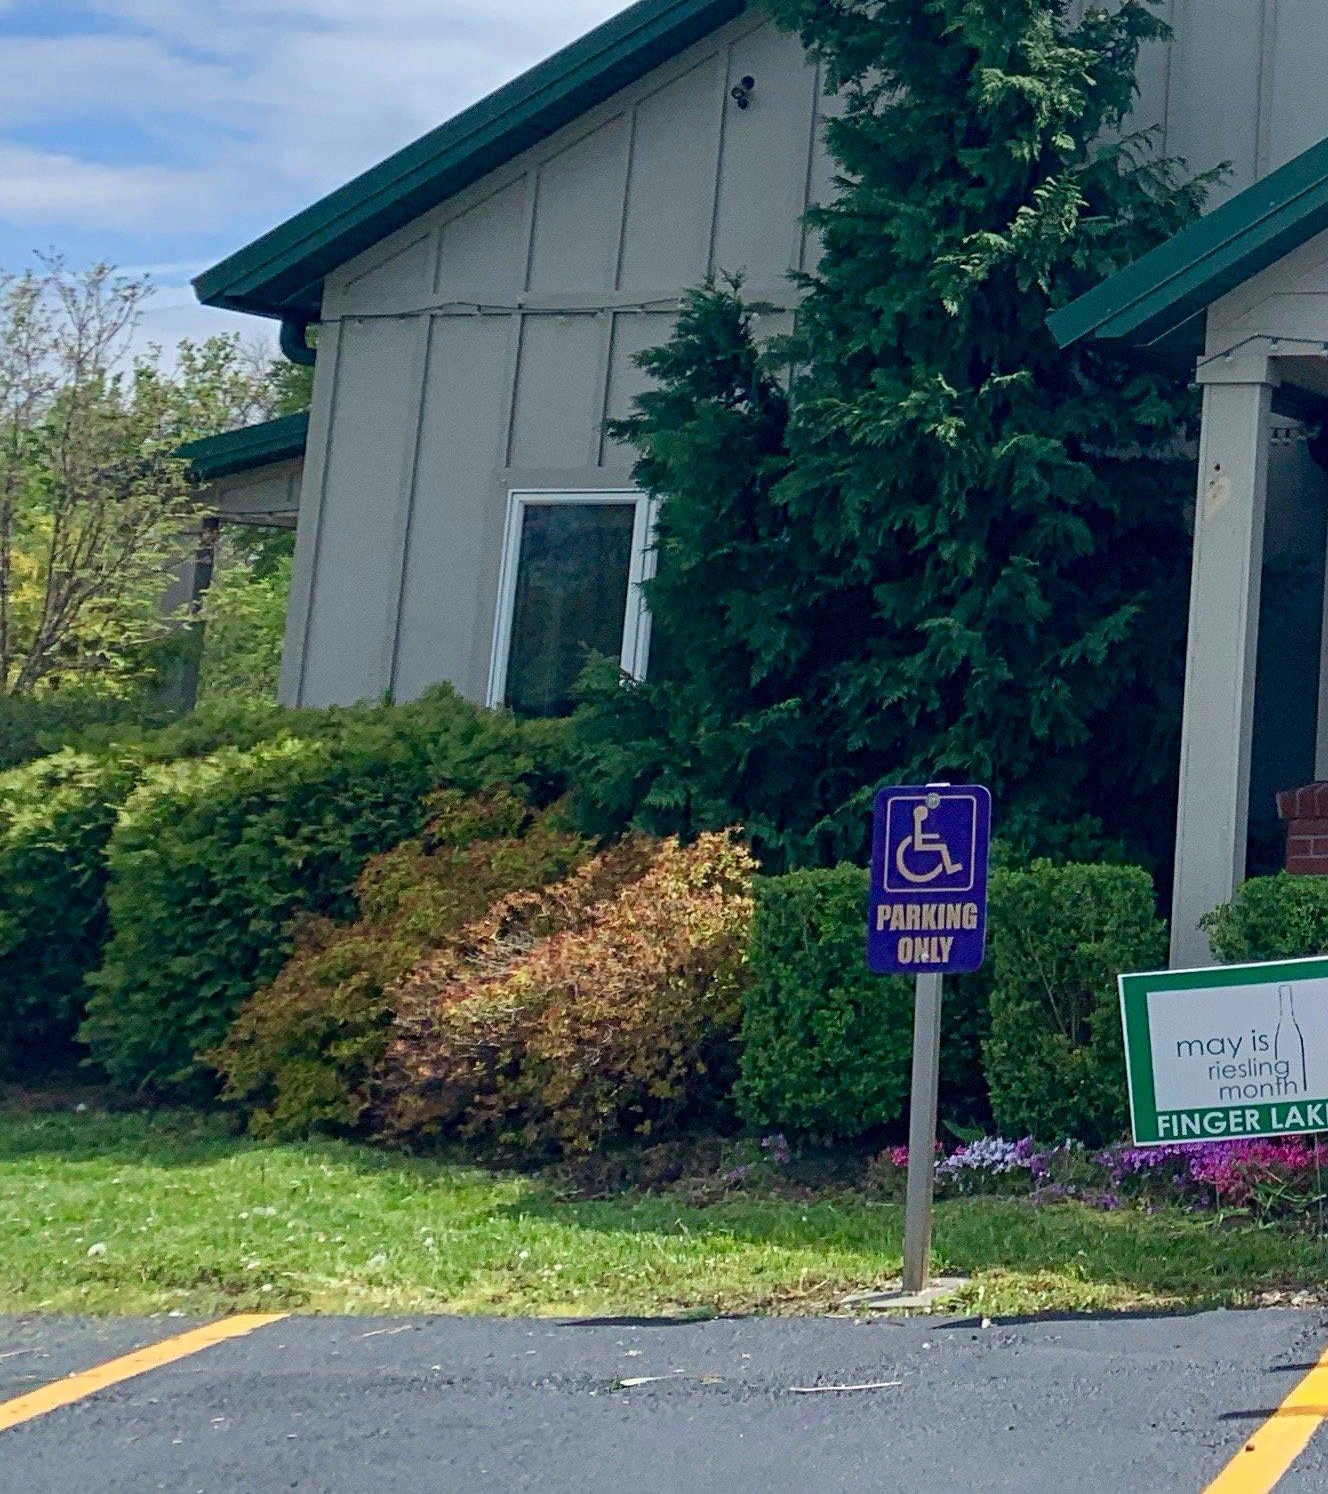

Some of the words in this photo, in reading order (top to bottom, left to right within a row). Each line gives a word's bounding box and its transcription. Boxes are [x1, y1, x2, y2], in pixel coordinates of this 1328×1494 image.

[876, 902, 978, 931] PARKING
[897, 936, 954, 964] ONLY
[1177, 1036, 1243, 1058] may
[1252, 1029, 1269, 1052] is
[1208, 1058, 1290, 1080] riesling
[1219, 1076, 1298, 1100] month
[1157, 1108, 1261, 1138] FINGER
